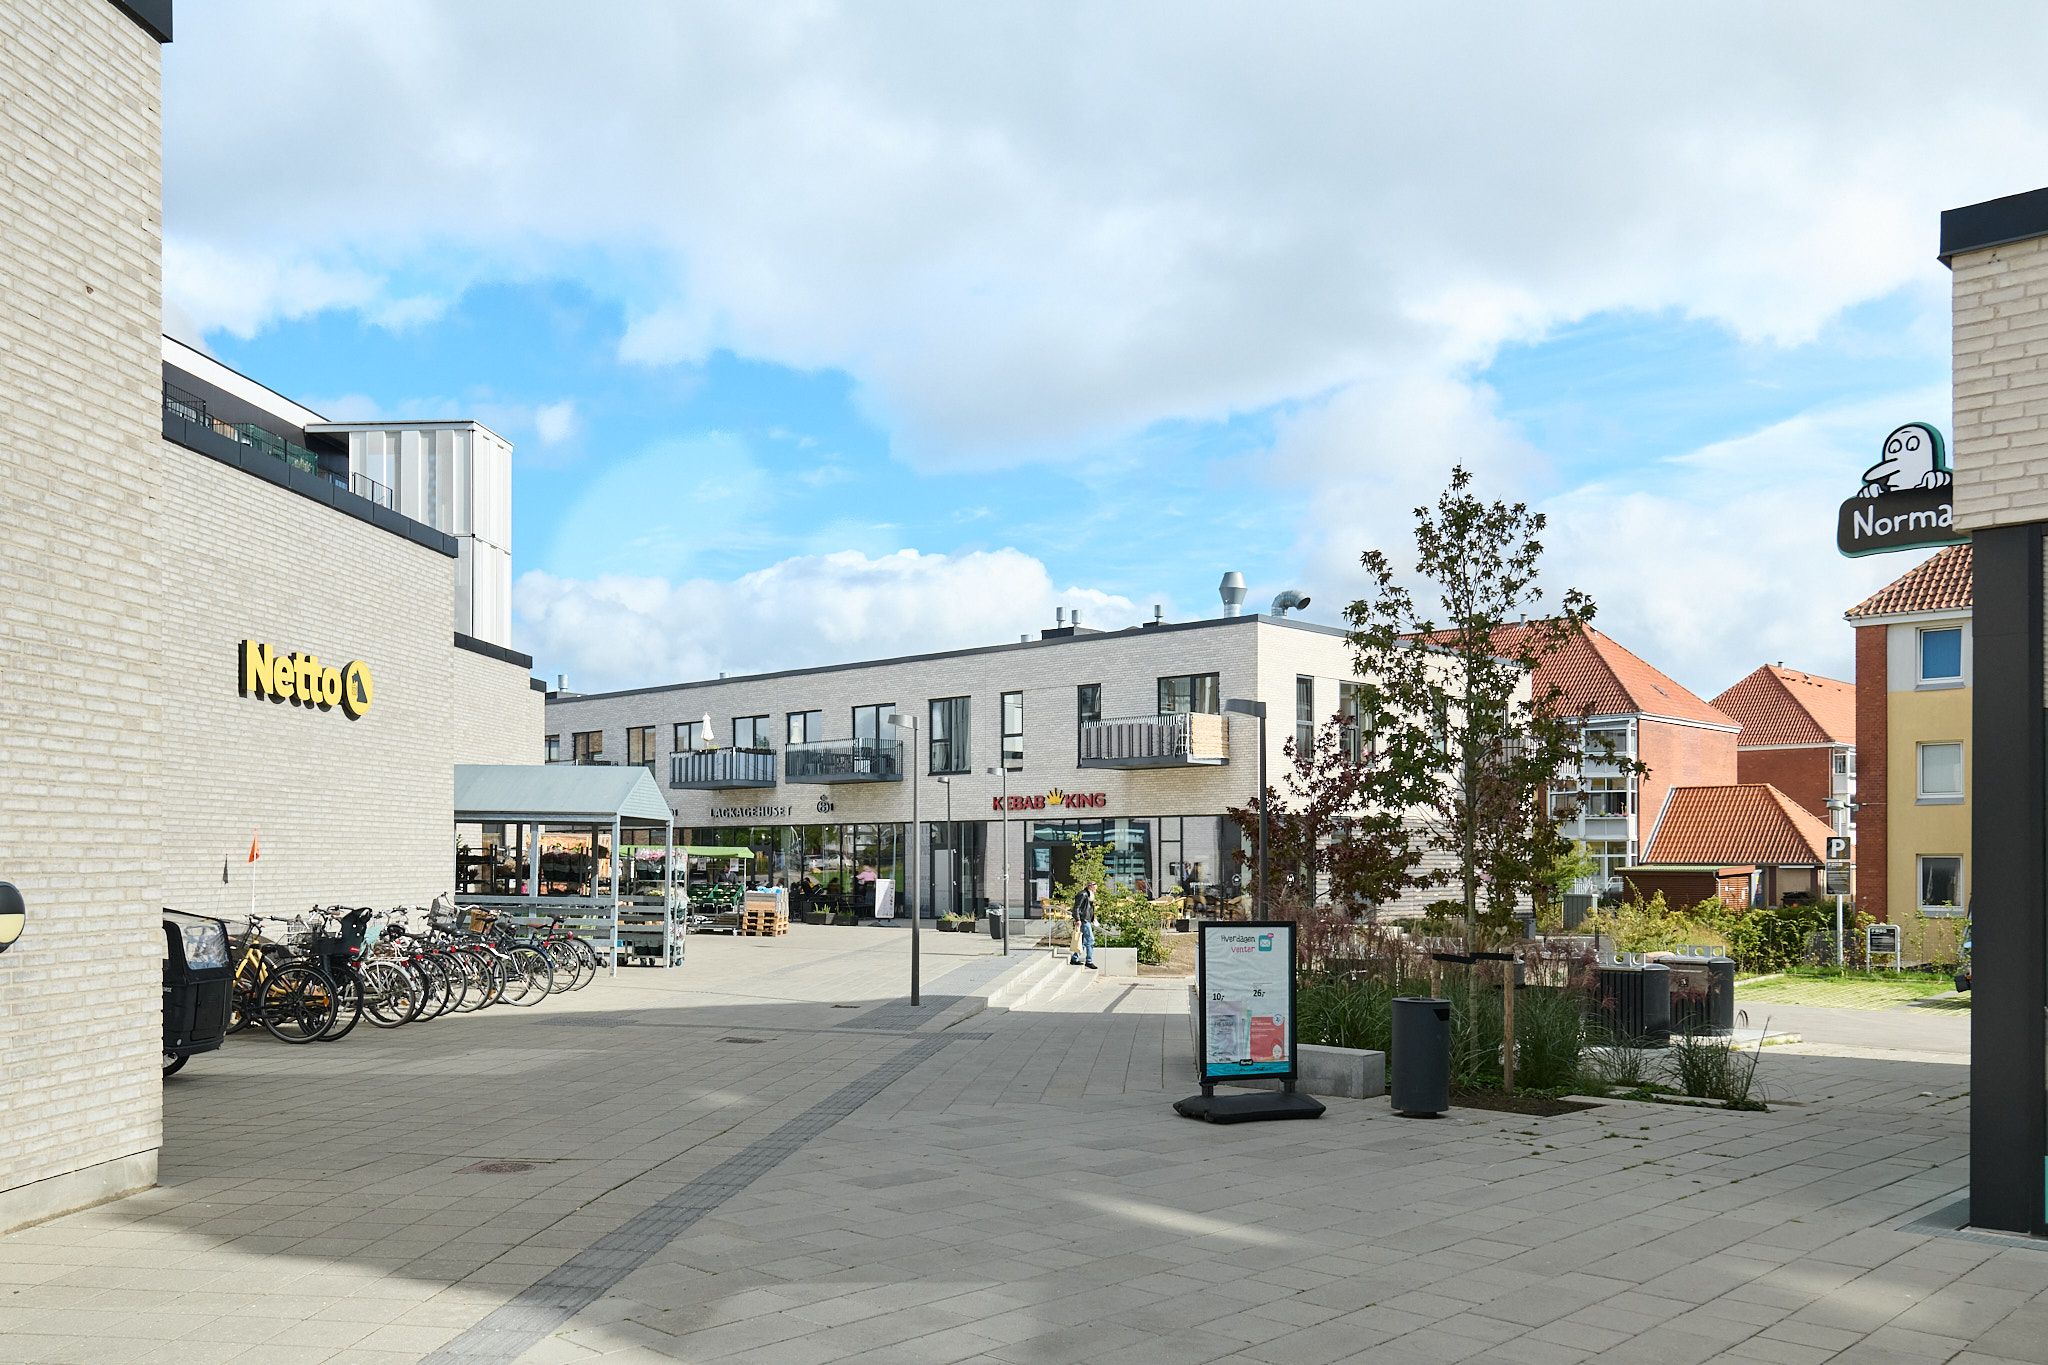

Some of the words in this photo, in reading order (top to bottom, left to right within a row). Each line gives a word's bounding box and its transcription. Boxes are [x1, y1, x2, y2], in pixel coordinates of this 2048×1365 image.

[1853, 505, 1953, 540] Norma
[243, 640, 343, 708] Netto
[710, 805, 793, 818] LAGKAGEHUSET
[992, 795, 1046, 811] KEBAB
[1064, 793, 1107, 809] KING
[1831, 838, 1846, 858] P
[1220, 935, 1256, 944] Hverdagen
